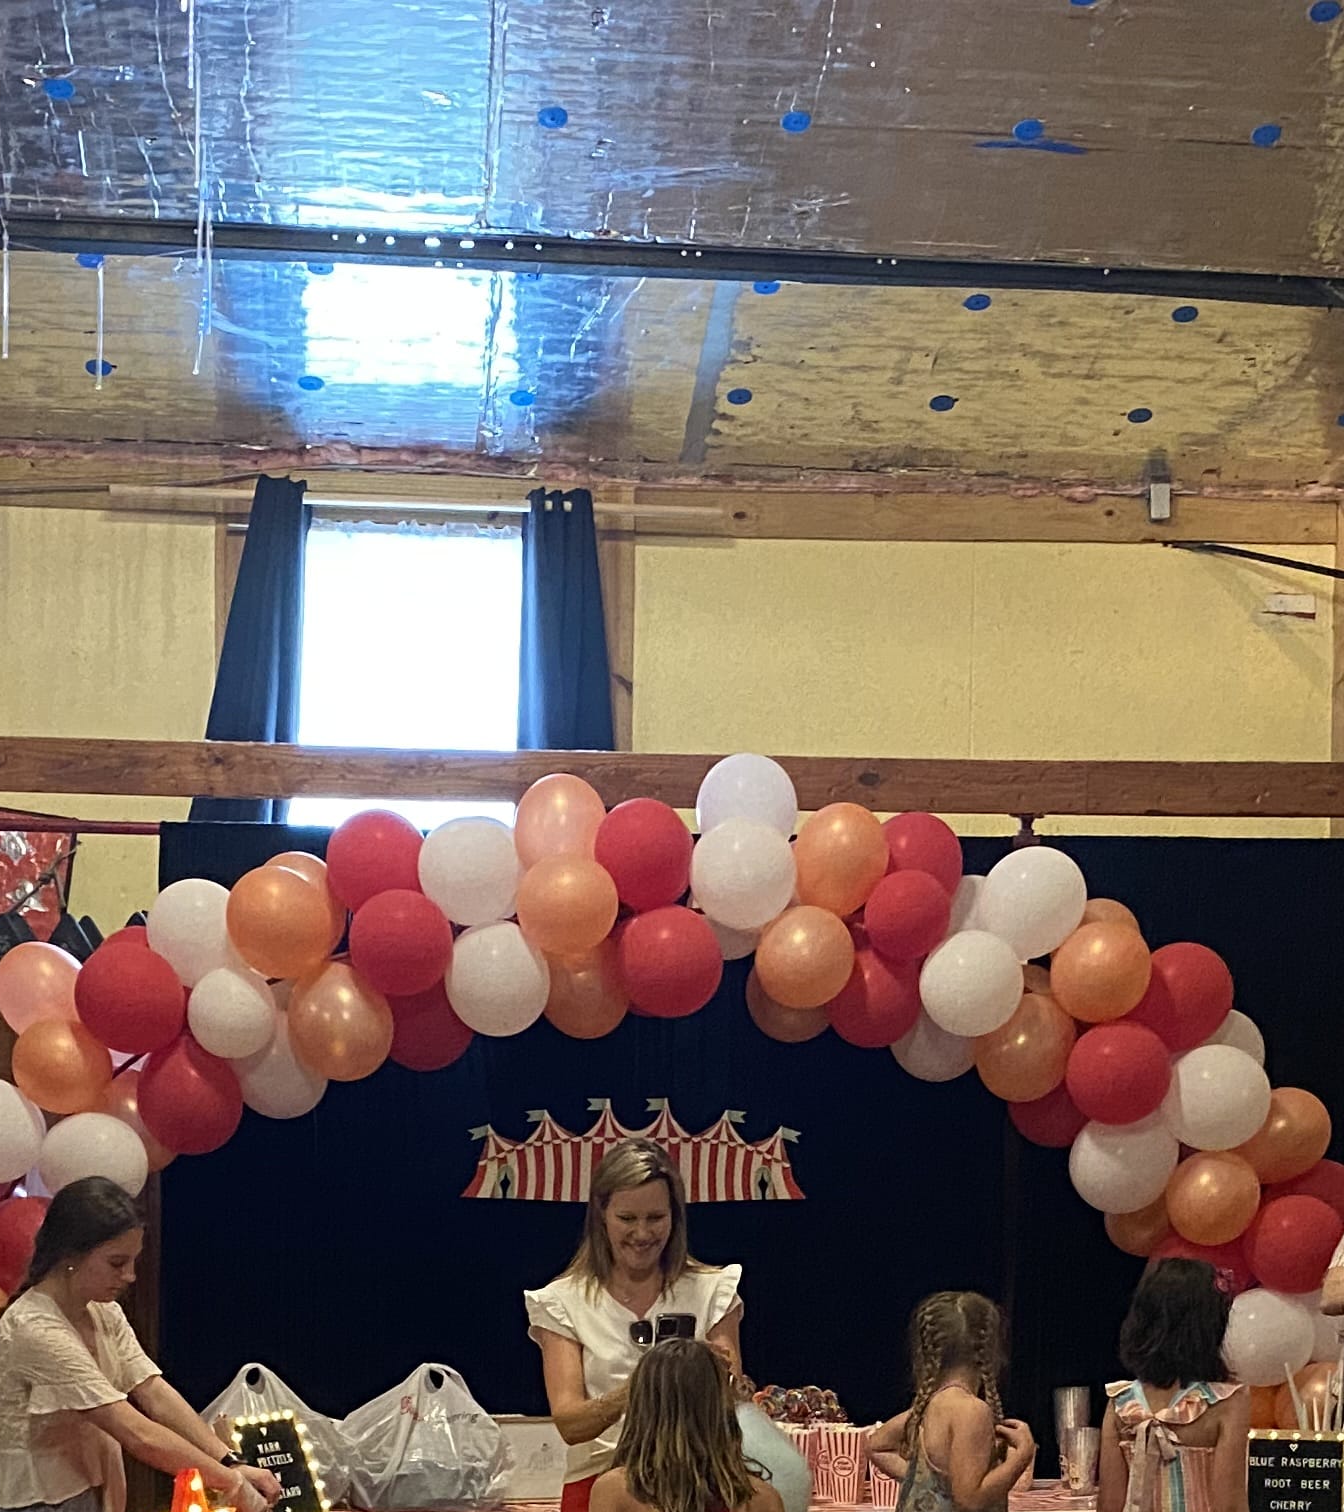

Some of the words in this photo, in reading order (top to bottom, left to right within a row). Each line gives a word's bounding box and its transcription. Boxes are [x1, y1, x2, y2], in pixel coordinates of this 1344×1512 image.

[257, 1442, 281, 1454] WARM
[257, 1453, 294, 1467] PRETZELS
[1249, 1456, 1275, 1466] BLUE
[1281, 1457, 1343, 1468] RASPBERRY
[1264, 1478, 1292, 1488] ROOT
[1300, 1479, 1330, 1490] BEER
[278, 1486, 302, 1499] TARD
[1270, 1500, 1312, 1510] CHERRY
